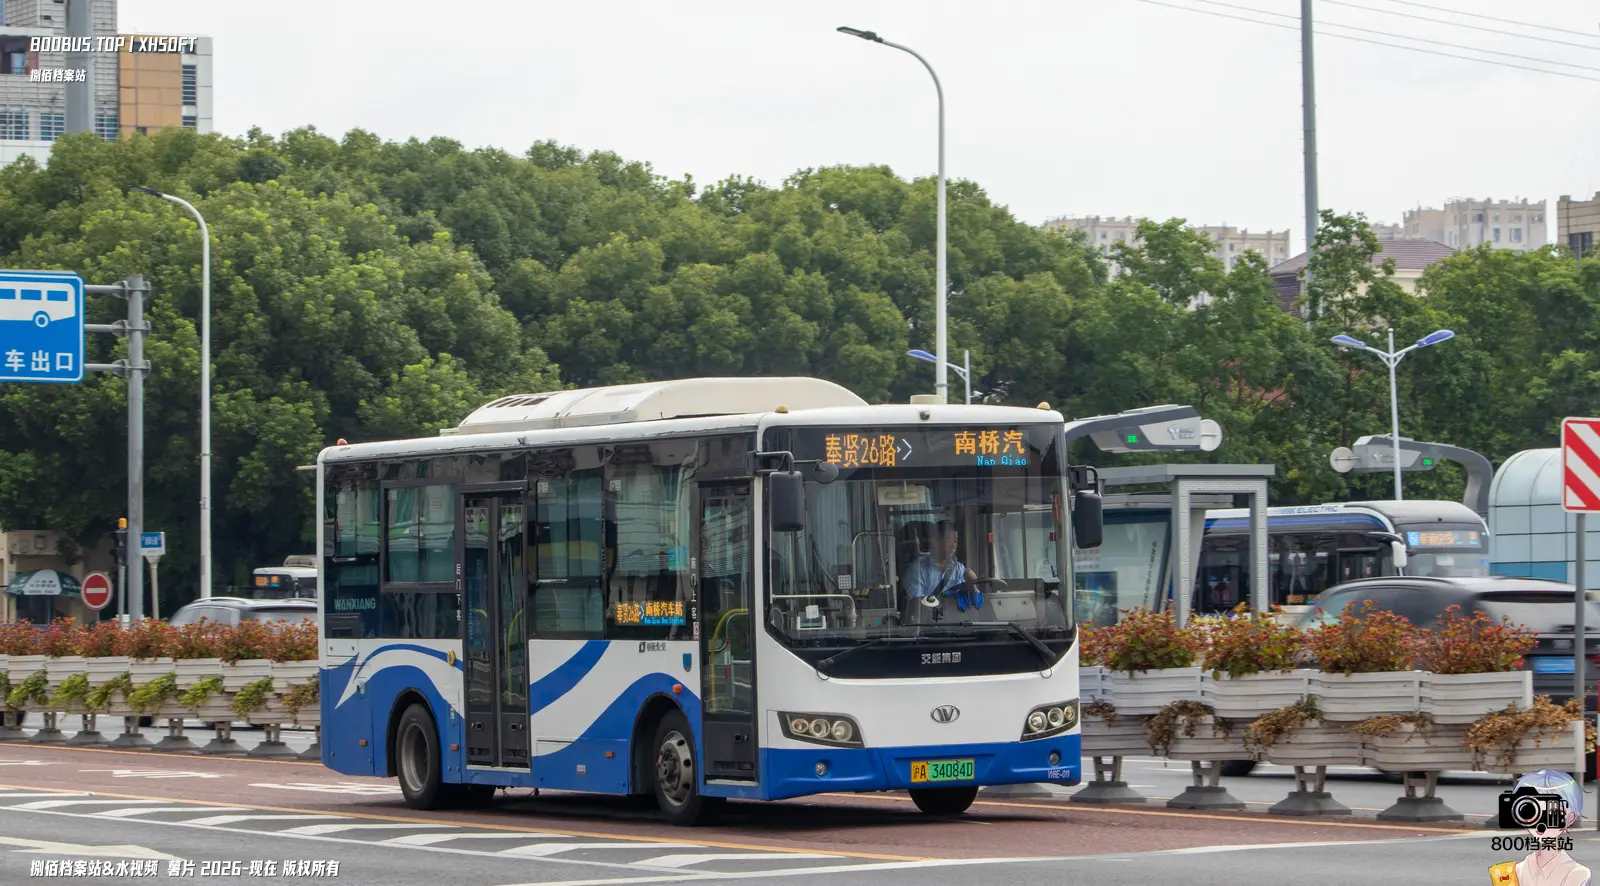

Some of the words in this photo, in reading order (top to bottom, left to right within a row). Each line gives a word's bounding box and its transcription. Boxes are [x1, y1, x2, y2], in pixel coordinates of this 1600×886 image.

[4, 349, 73, 372] 车出口
[825, 433, 897, 468] 奉贤26路
[954, 430, 1026, 455] 南桥汽
[976, 455, 996, 467] Nan
[1001, 455, 1028, 467] Qiao
[334, 597, 376, 611] WANXIANG
[645, 601, 683, 617] 南桥汽车站
